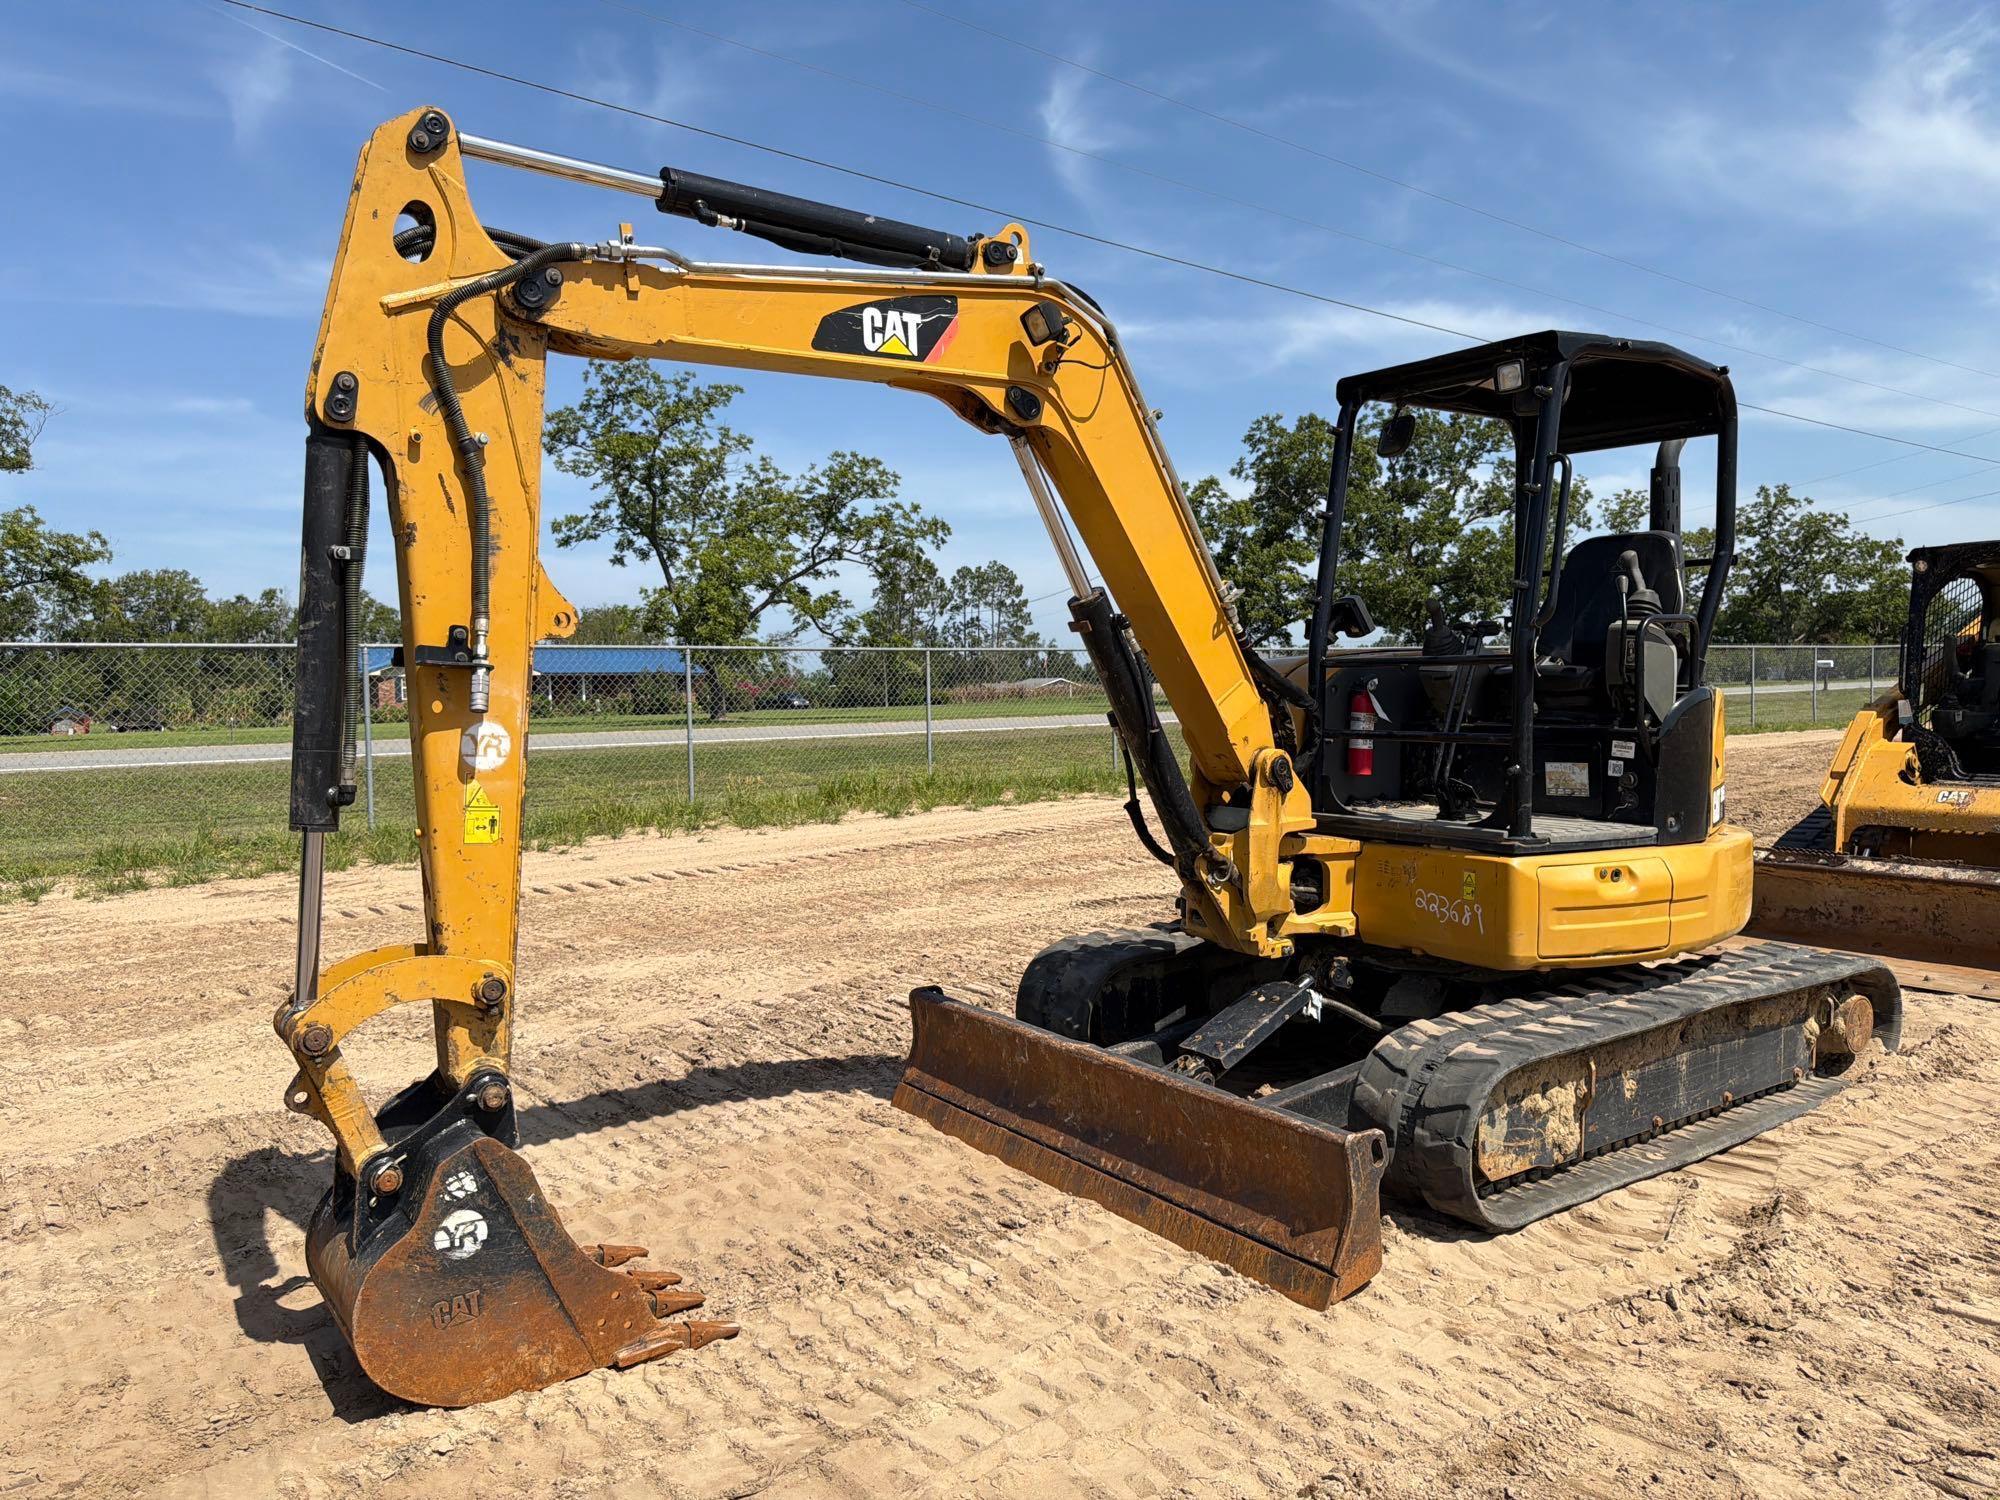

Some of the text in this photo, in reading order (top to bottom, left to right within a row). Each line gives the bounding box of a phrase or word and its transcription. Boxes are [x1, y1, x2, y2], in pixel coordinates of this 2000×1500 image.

[862, 306, 922, 357] CAT
[1936, 790, 1970, 804] CAT
[1415, 888, 1484, 935] 223689
[431, 1289, 481, 1331] CAT
